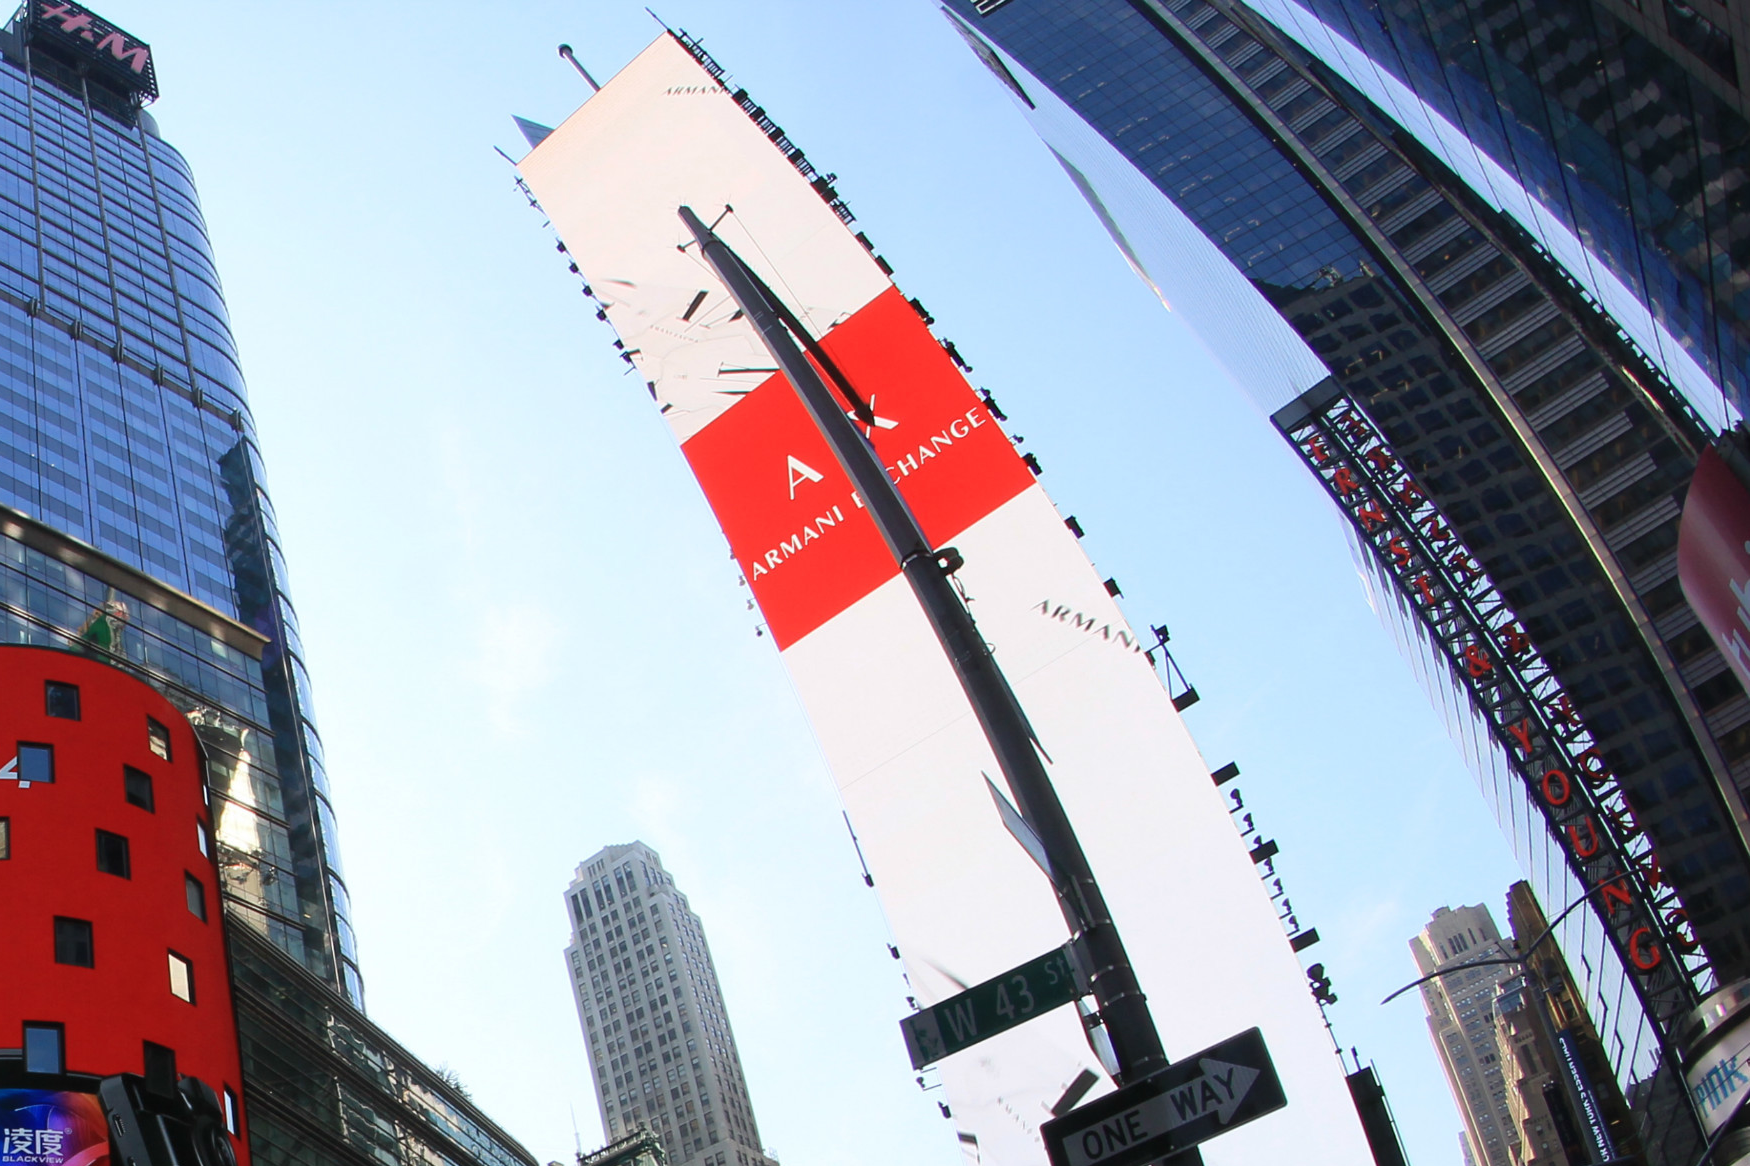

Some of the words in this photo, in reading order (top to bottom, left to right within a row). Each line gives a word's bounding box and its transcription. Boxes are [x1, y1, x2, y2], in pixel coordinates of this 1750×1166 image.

[752, 504, 845, 581] ARMANI
[850, 406, 987, 509] ECHANGE
[787, 454, 824, 500] A
[1026, 598, 1142, 654] ARMANI
[1508, 717, 1662, 971] YOUNG
[944, 998, 978, 1043] W
[995, 974, 1036, 1021] 43
[2, 1127, 64, 1157] 凌度
[1081, 1110, 1148, 1161] ONE
[1169, 1067, 1237, 1121] WAY
[1, 1155, 65, 1164] BLACKVIEW
